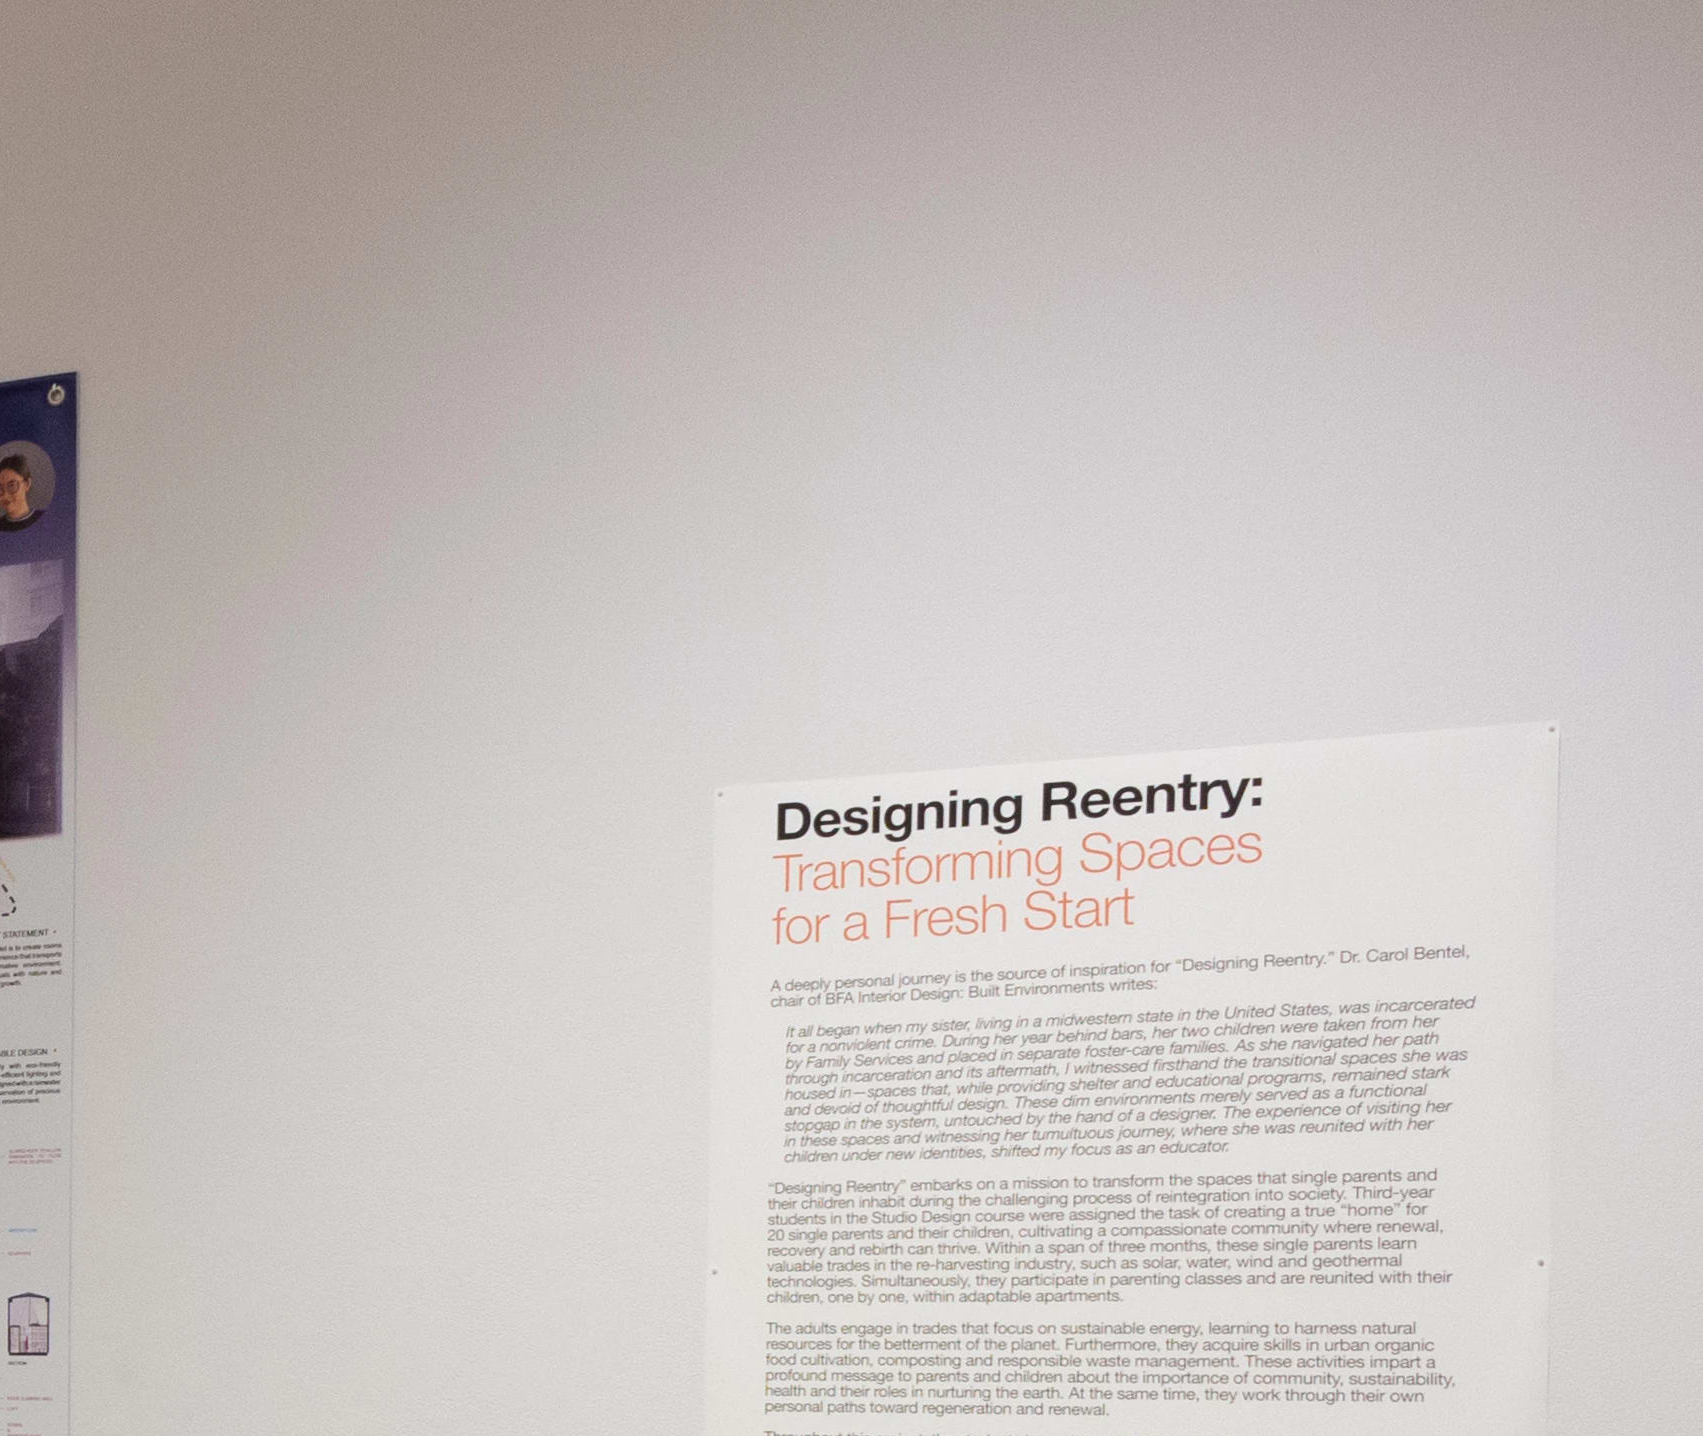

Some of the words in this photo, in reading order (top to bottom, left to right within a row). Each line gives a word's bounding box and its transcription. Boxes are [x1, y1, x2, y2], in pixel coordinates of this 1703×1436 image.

[776, 789, 1023, 843] Designing
[1042, 773, 1263, 822] Reentry:
[773, 840, 1062, 892] Transforming
[1080, 832, 1263, 881] Spaces
[3, 928, 49, 940] STATEMENT
[772, 906, 830, 945] for
[843, 911, 870, 942] a
[886, 894, 1007, 939] Fresh
[1024, 887, 1135, 931] Start
[770, 979, 782, 991] A
[784, 977, 831, 992] deeply
[834, 974, 895, 990] personal
[898, 973, 952, 987] journey
[954, 970, 967, 982] is
[970, 969, 994, 981] the
[997, 968, 1048, 980] source
[1050, 964, 1066, 977] of
[1069, 962, 1146, 978] inspiration
[1150, 959, 1172, 973] for
[1175, 956, 1259, 972] “Designing
[1263, 951, 1335, 968] Reentry.”
[1339, 950, 1361, 963] Dr.
[1365, 947, 1409, 962] Carol
[1413, 944, 1470, 961] Bentel,
[768, 1181, 842, 1196] “Designing
[846, 1179, 906, 1194] Reentry”
[910, 1178, 973, 1191] embarks
[976, 1180, 996, 1190] on
[998, 1179, 1009, 1189] a
[1012, 1176, 1070, 1189] mission
[1072, 1176, 1089, 1188] to
[1092, 1174, 1165, 1187] transform
[1168, 1173, 1194, 1186] the
[1197, 1174, 1253, 1187] spaces
[1256, 1171, 1287, 1184] that
[1291, 1170, 1338, 1185] single
[1341, 1169, 1403, 1184] parents
[1406, 1167, 1438, 1181] and
[765, 1368, 828, 1383] profound
[830, 1371, 895, 1384] message
[897, 1370, 913, 1381] to
[915, 1371, 970, 1384] parents
[972, 1369, 1002, 1382] and
[1004, 1369, 1063, 1382] children
[1066, 1370, 1110, 1383] about
[1114, 1370, 1139, 1383] the
[1142, 1370, 1230, 1385] importance
[1233, 1370, 1250, 1383] of
[1252, 1372, 1344, 1386] community,
[1348, 1372, 1455, 1387] sustainability,
